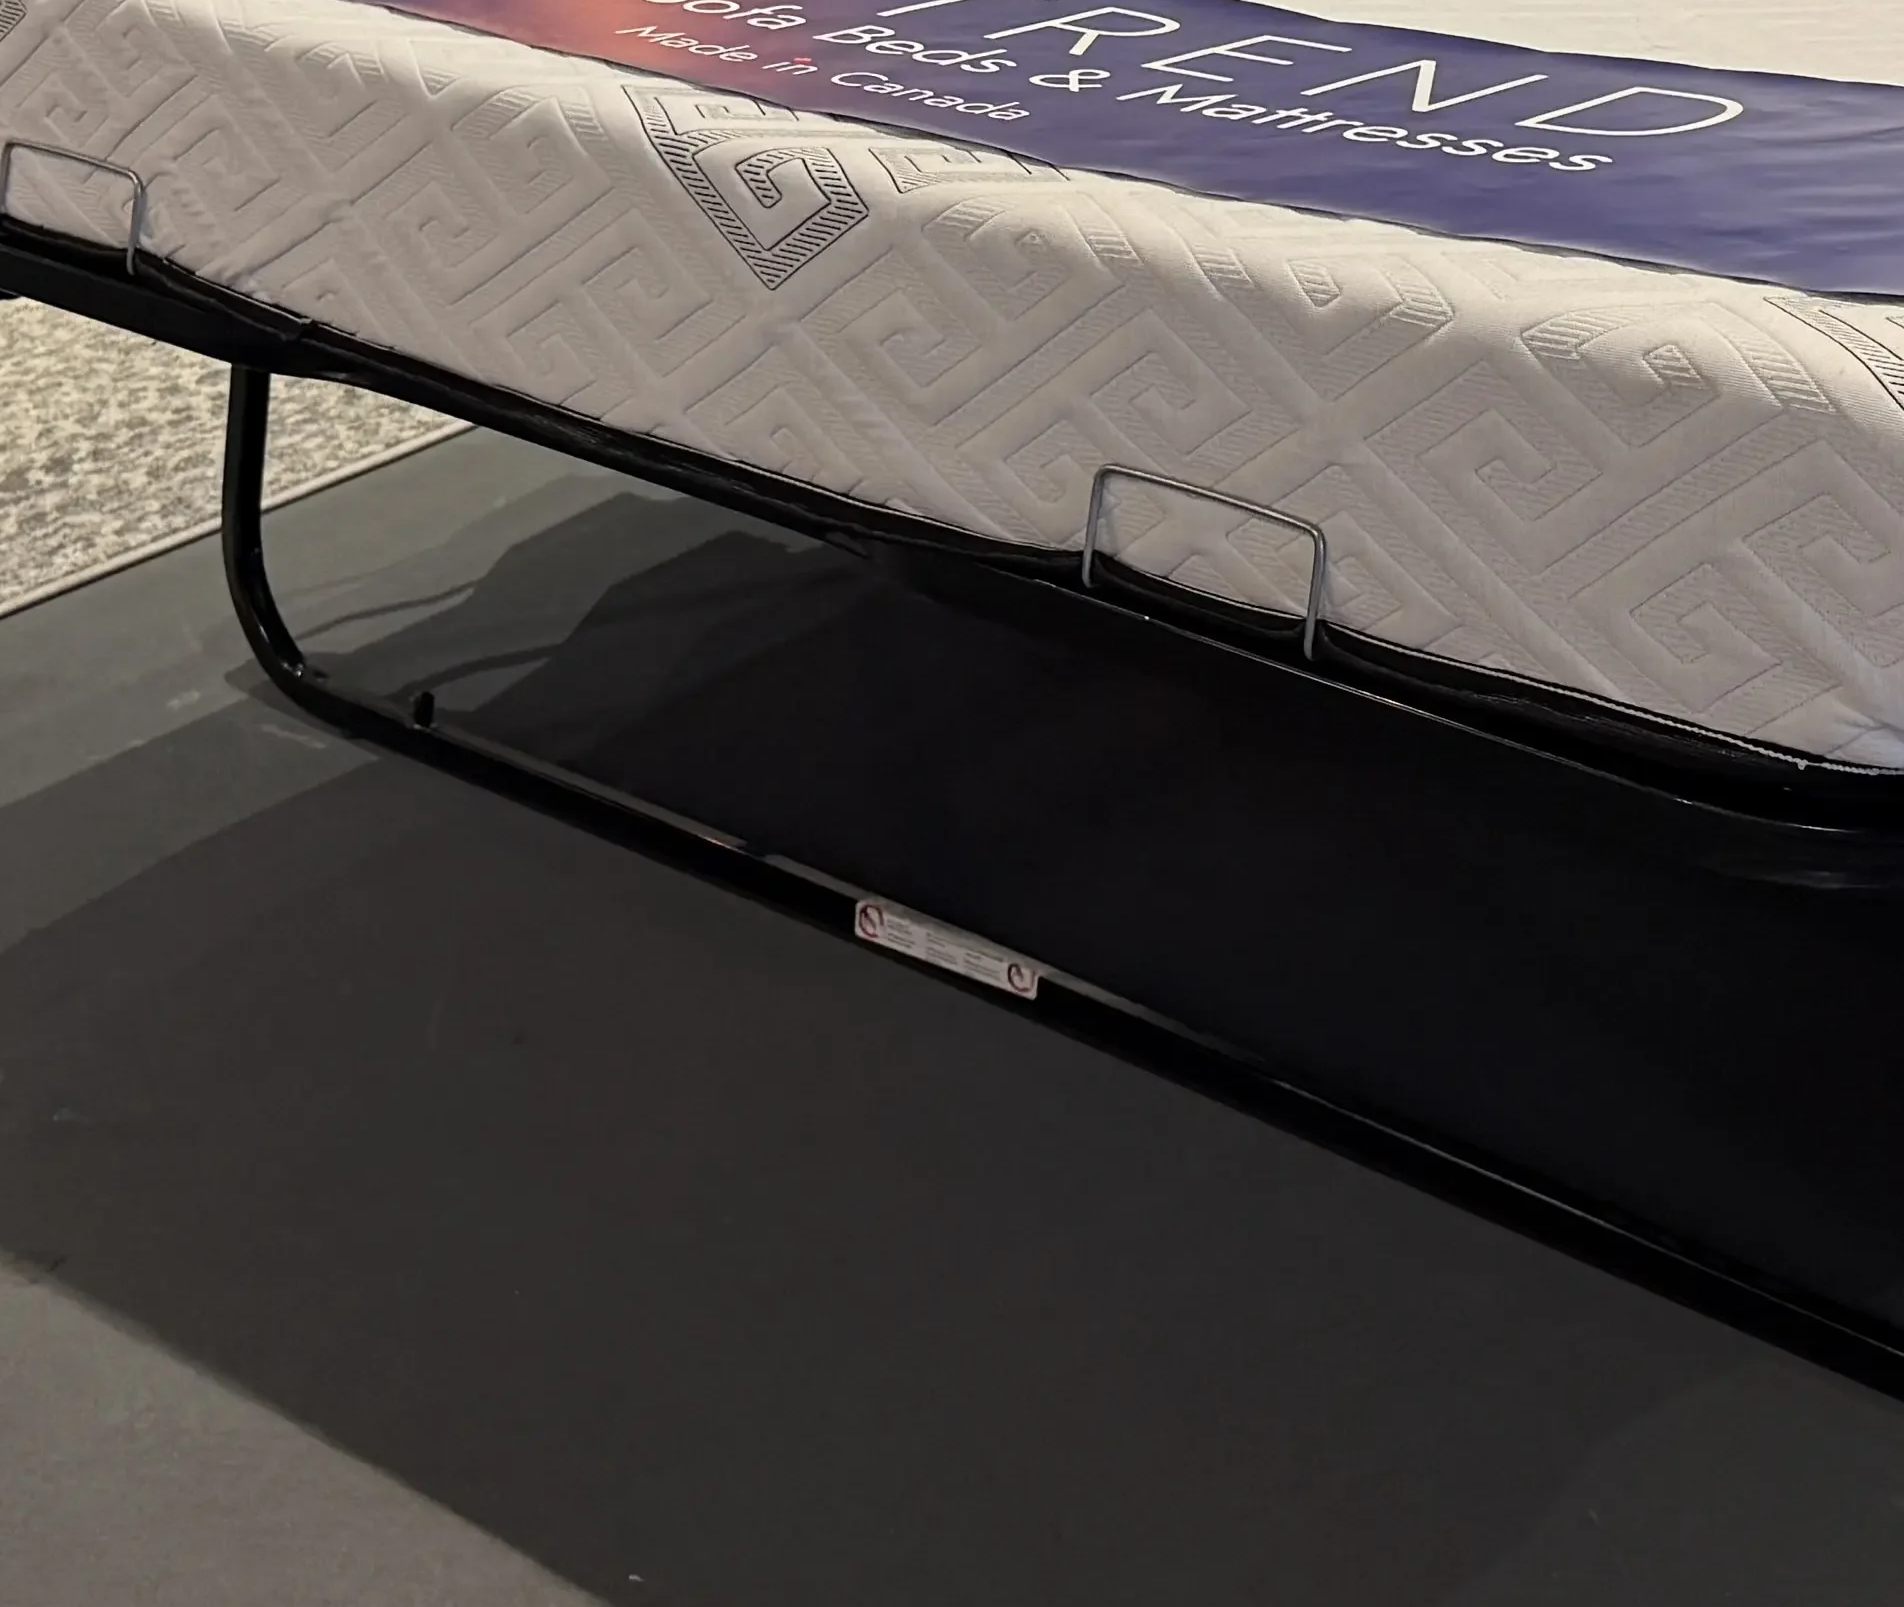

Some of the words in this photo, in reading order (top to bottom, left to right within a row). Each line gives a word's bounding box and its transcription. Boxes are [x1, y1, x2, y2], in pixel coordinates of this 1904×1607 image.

[615, 23, 760, 64] Made
[761, 56, 819, 76] in
[830, 70, 1031, 123] Canada
[813, 24, 1019, 77] Beds
[1028, 66, 1113, 94] &
[1115, 82, 1615, 173] Mattresses
